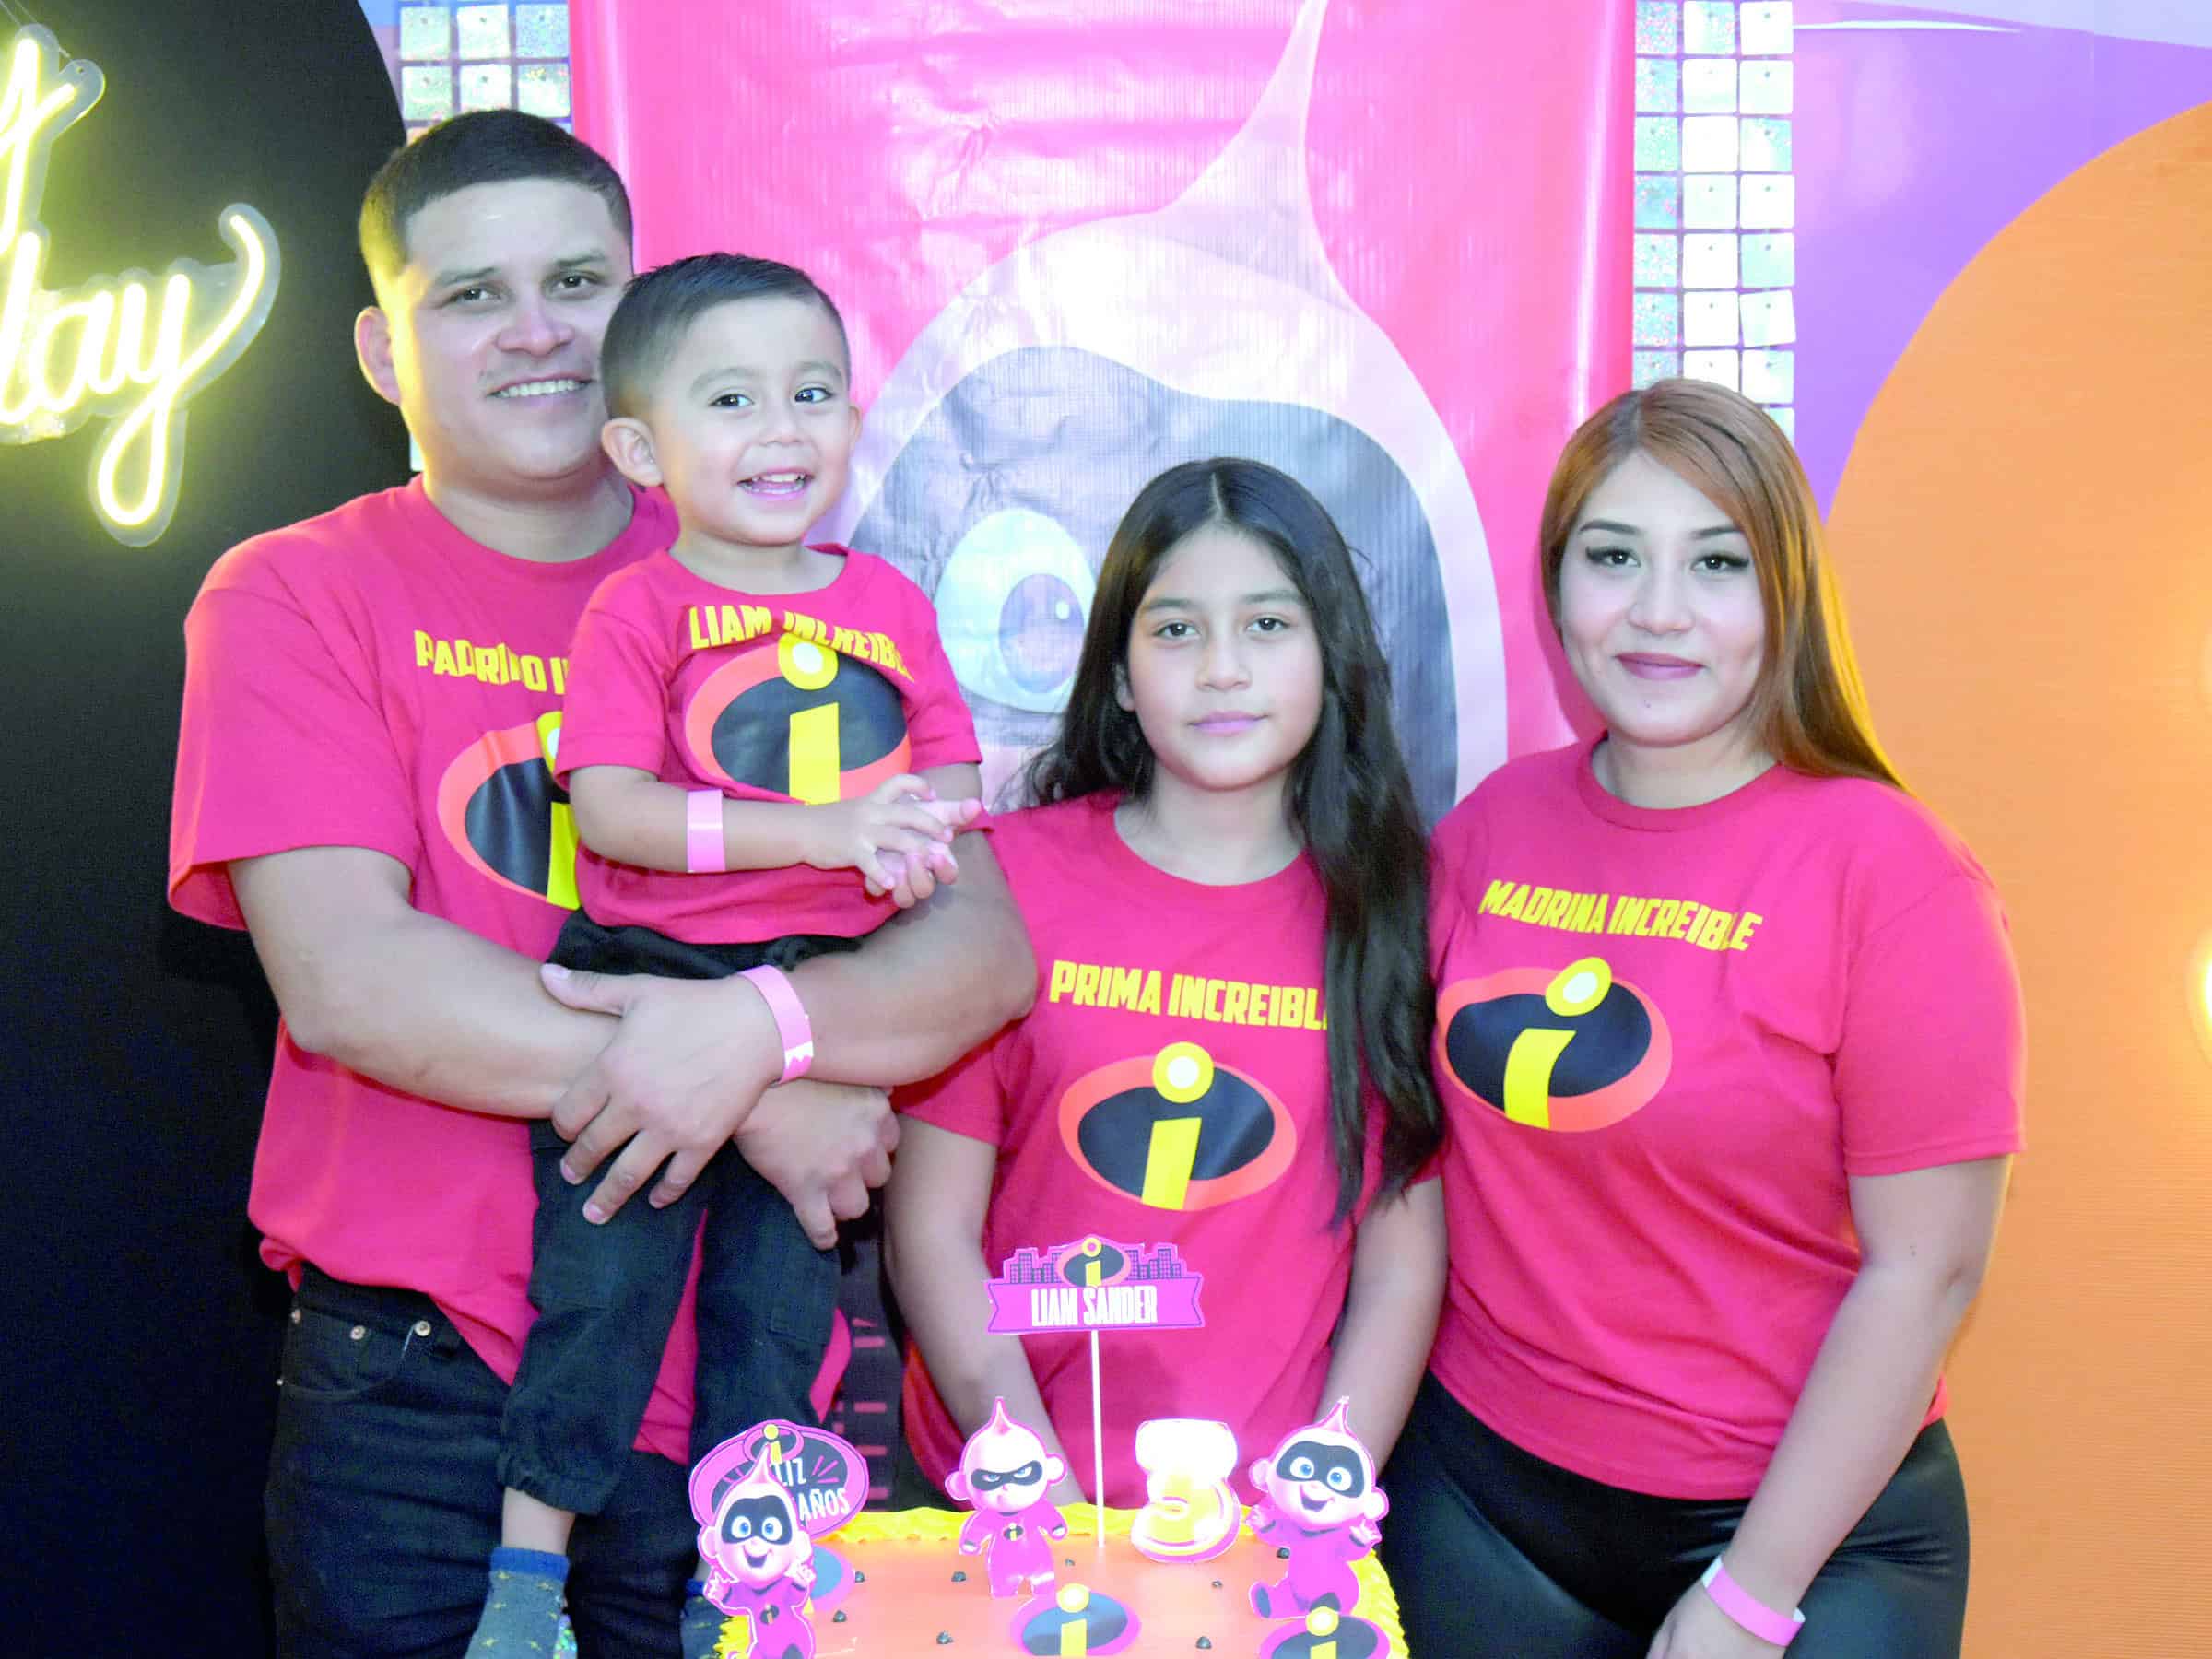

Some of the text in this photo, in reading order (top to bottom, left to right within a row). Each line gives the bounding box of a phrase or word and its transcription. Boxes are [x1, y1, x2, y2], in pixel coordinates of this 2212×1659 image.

[691, 604, 772, 650] LIAM
[1478, 879, 1764, 952] MADRINA INCREIBLE
[1049, 959, 1327, 1030] PRIMA INCREIBL
[1030, 1286, 1158, 1327] LIAM SANDER
[772, 1457, 807, 1487] LIZ
[798, 1488, 851, 1521] AÑOS
